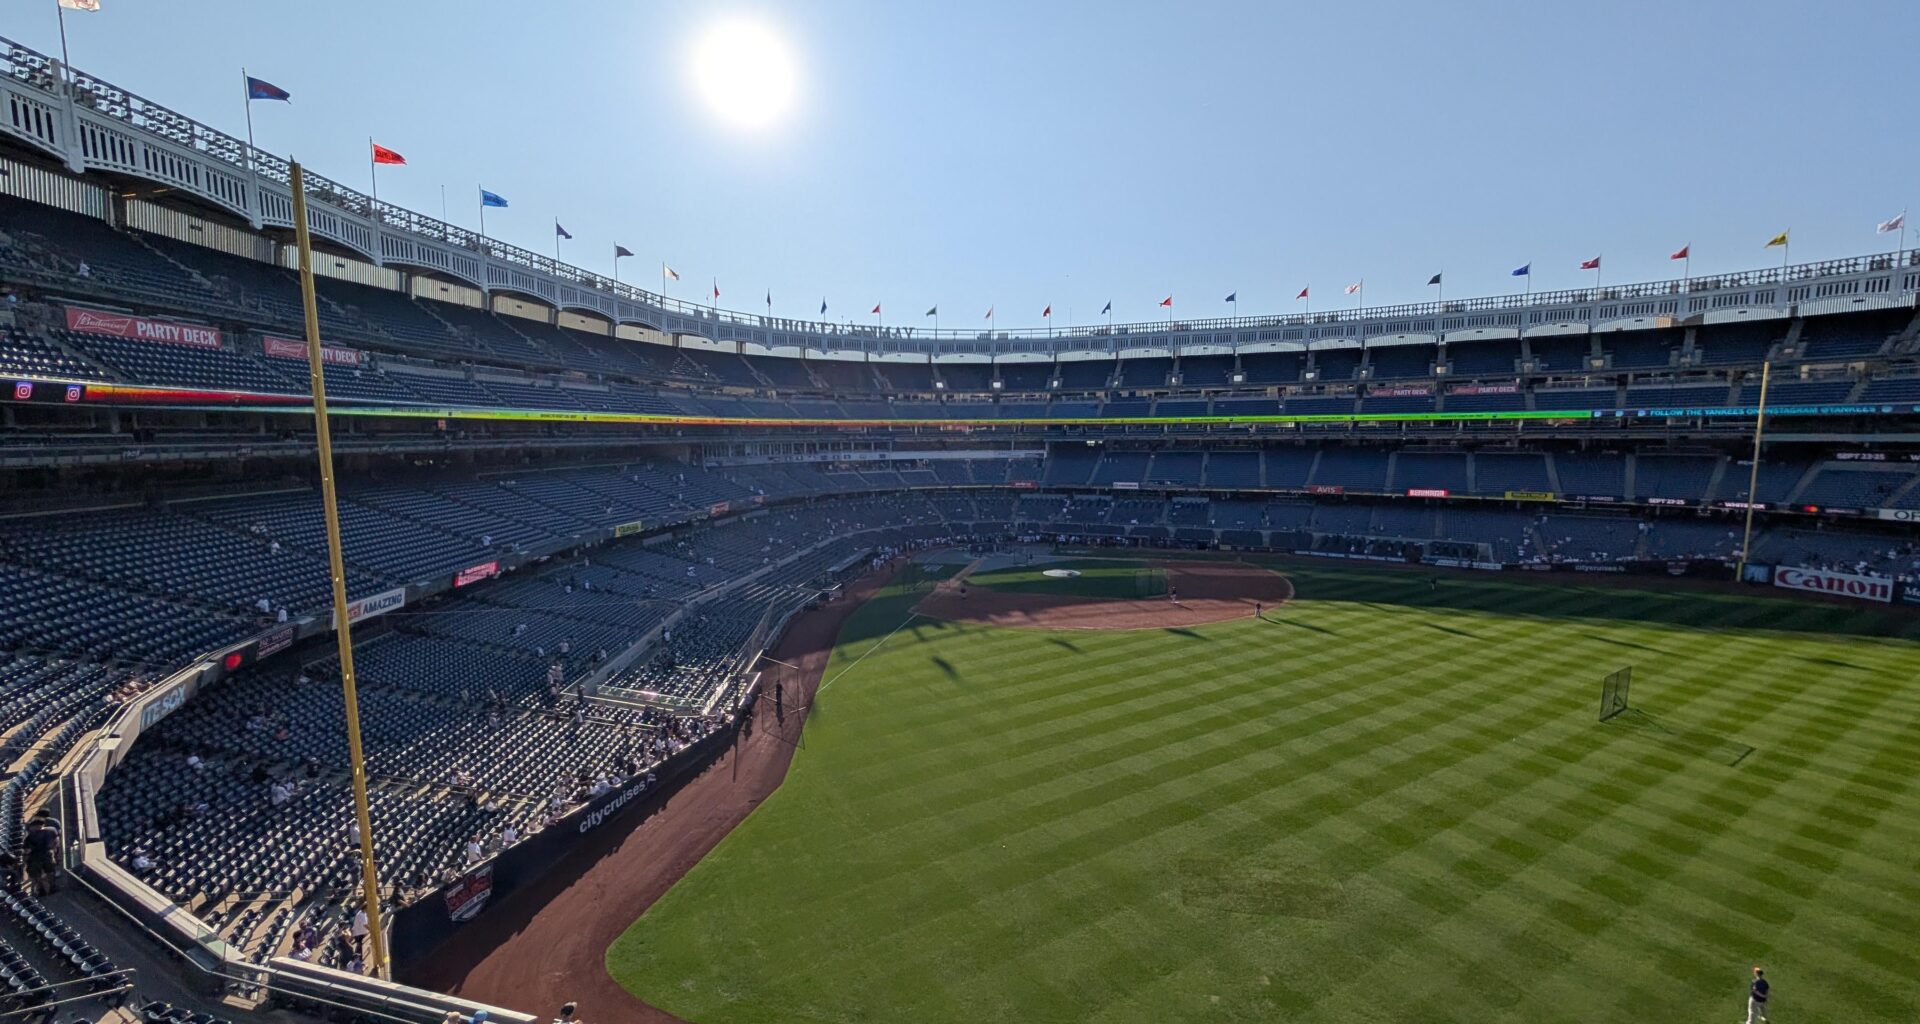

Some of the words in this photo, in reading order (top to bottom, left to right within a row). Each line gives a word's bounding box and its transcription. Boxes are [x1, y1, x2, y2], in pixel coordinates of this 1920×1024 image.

[136, 321, 180, 341] PARTY
[183, 328, 218, 346] DECK
[335, 350, 358, 364] DECK
[1650, 408, 1684, 416] FOLLOW
[1777, 569, 1889, 599] Canon
[363, 594, 403, 615] AMAZING
[162, 683, 186, 711] SOX
[580, 780, 646, 833] citycruises
